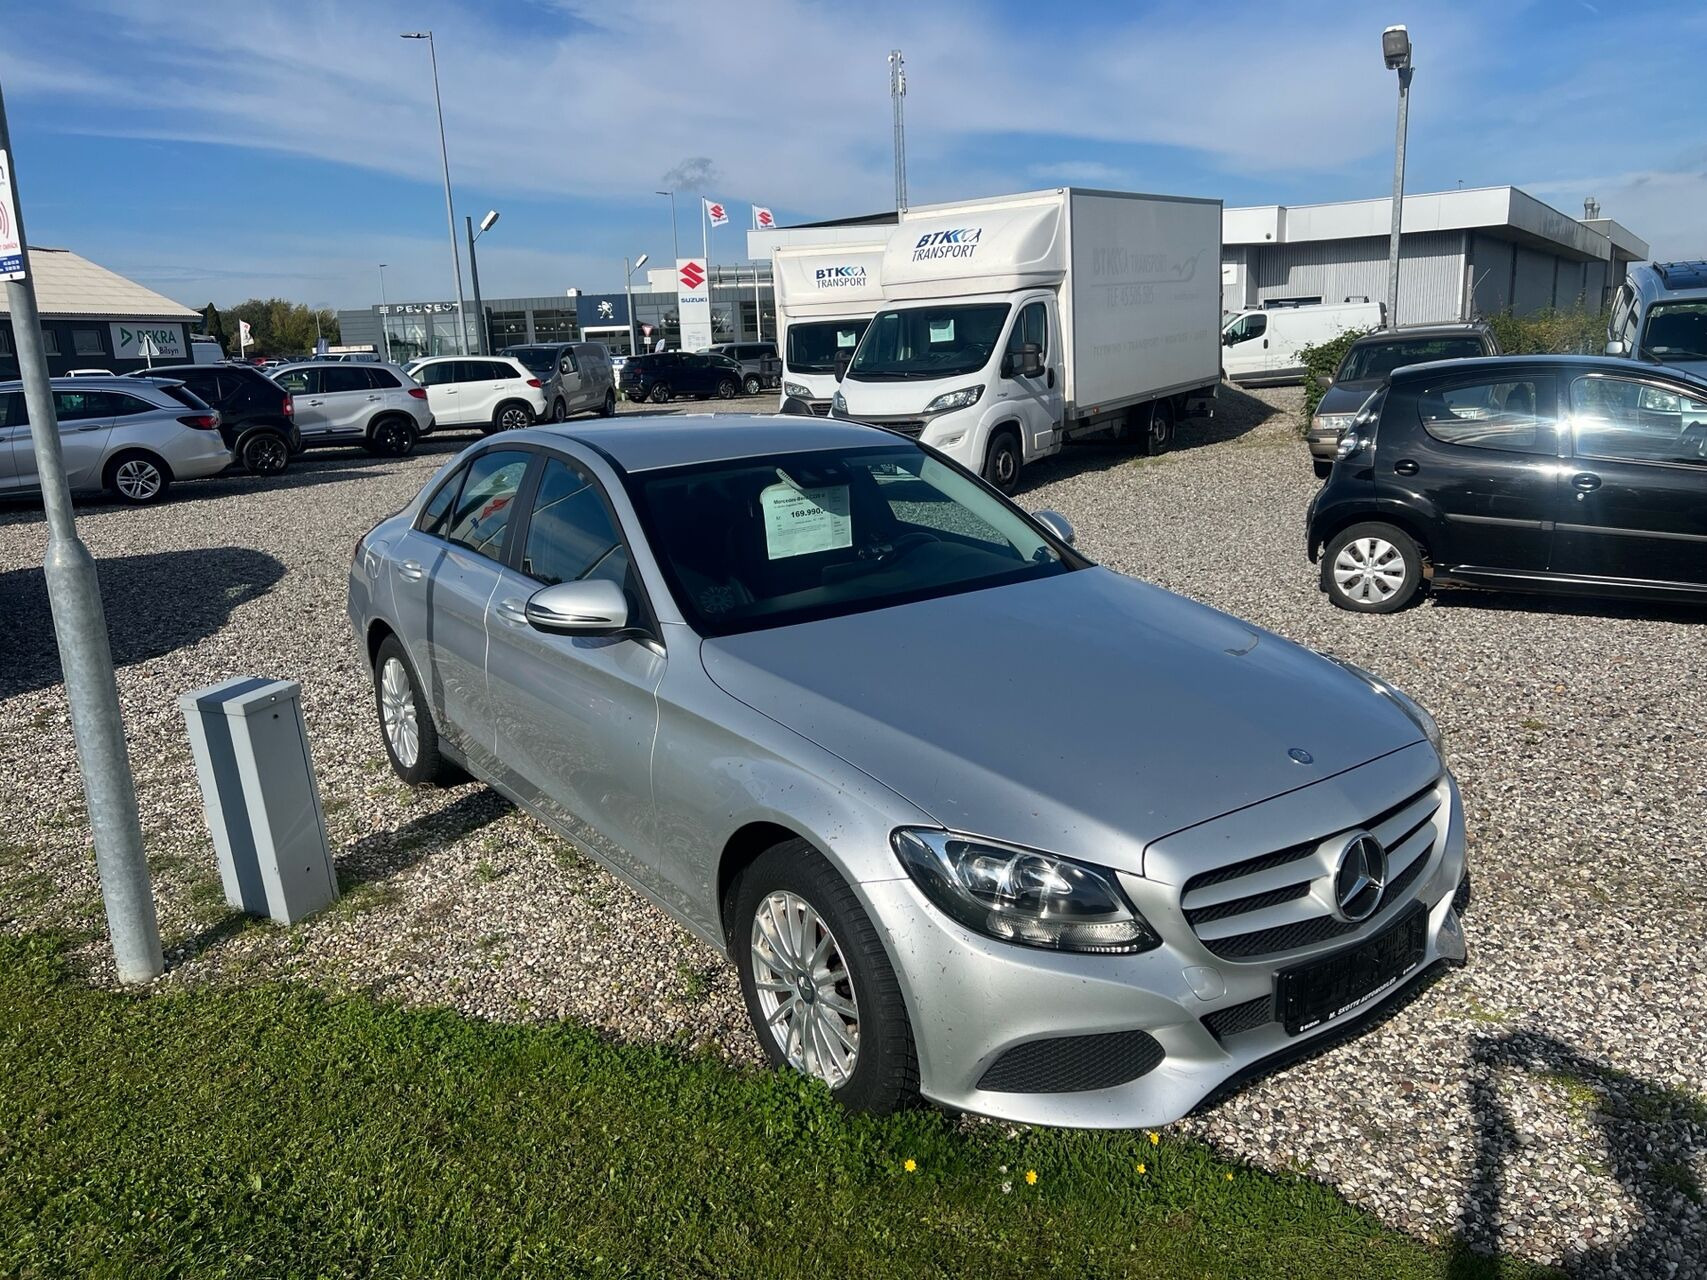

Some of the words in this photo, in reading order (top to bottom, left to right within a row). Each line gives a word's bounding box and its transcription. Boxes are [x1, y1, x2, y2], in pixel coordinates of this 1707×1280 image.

[912, 245, 977, 262] TRANSPORT
[816, 277, 866, 289] TRANSPORT
[159, 345, 179, 356] Bilsyn
[1338, 998, 1361, 1015] SKOTTE
